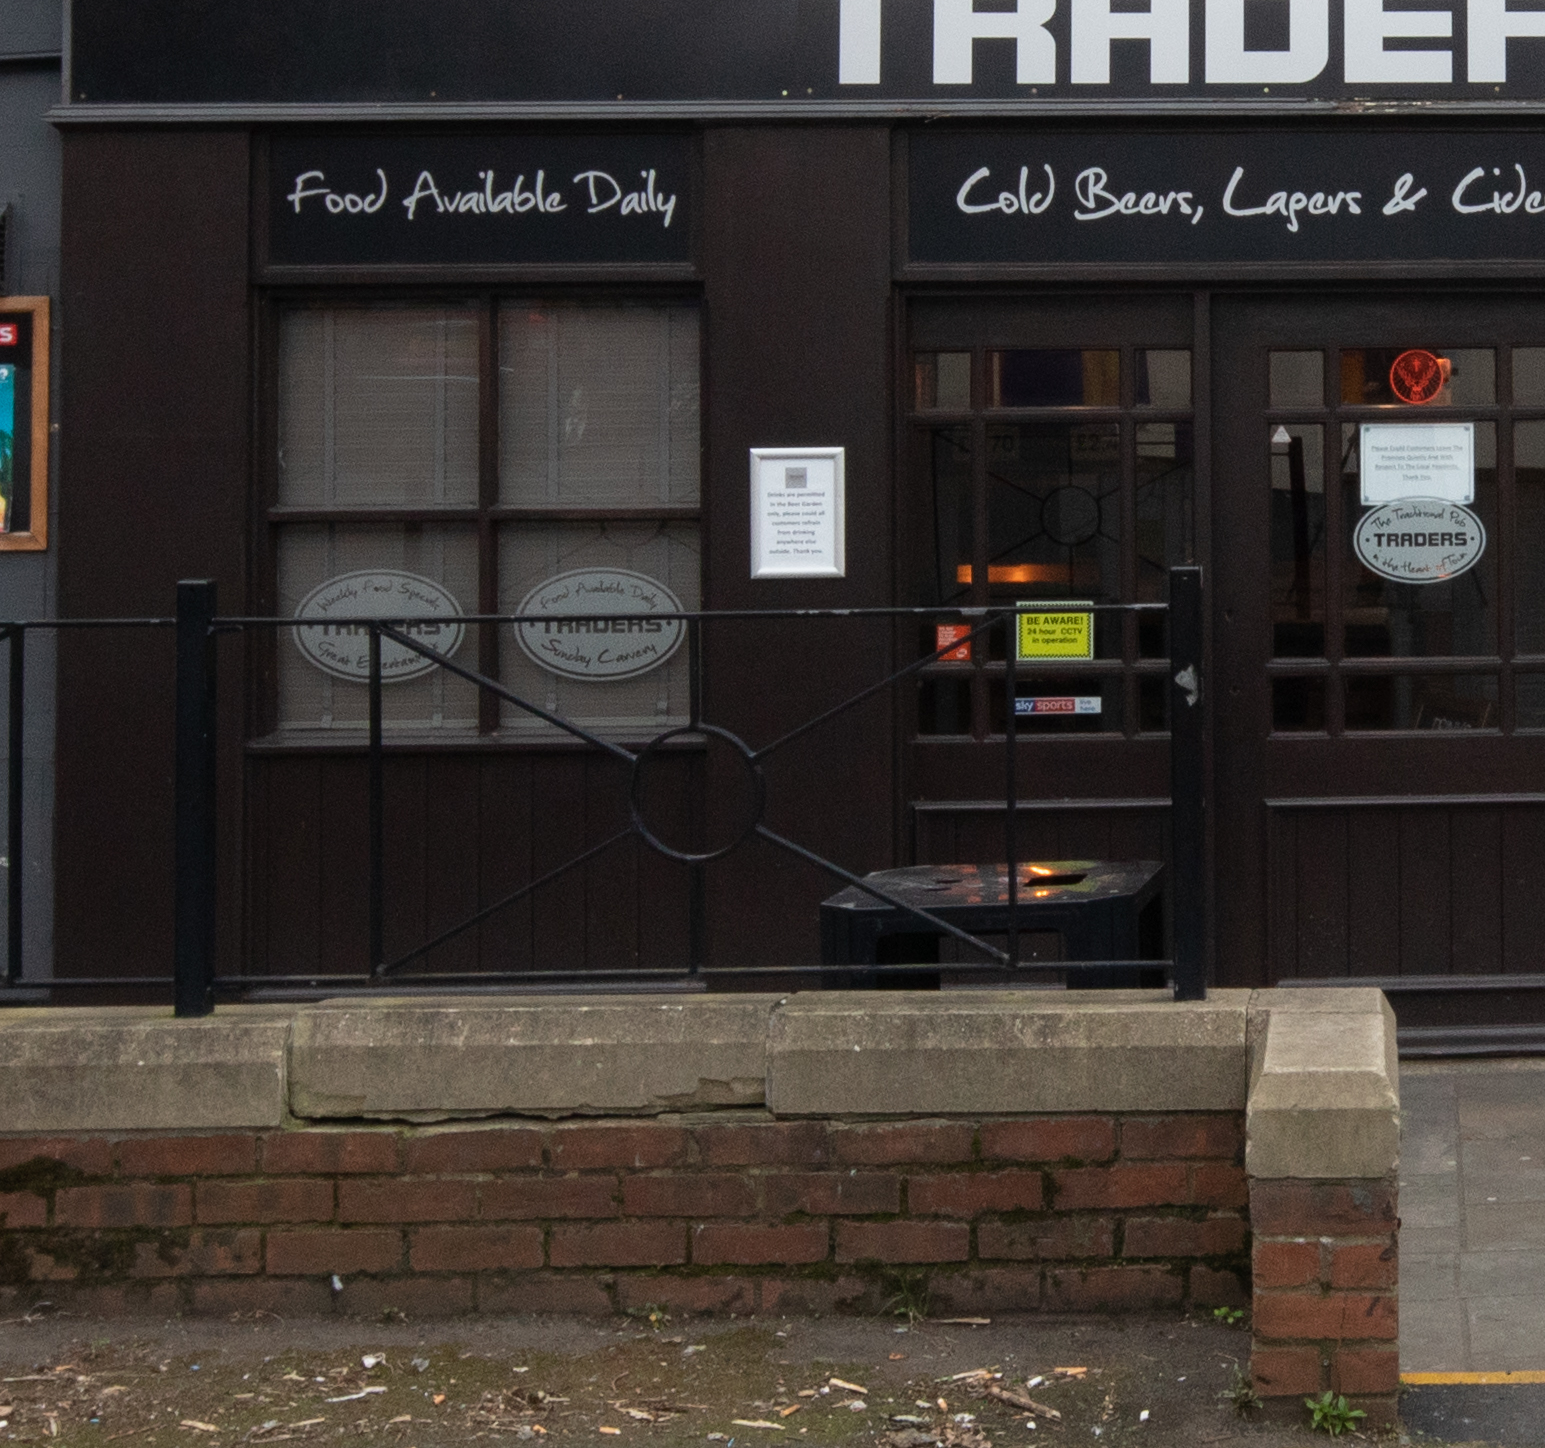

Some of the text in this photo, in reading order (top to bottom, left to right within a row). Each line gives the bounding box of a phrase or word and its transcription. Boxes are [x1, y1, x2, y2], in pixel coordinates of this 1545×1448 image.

[288, 169, 677, 227] Food Available Daily
[956, 166, 1054, 214] Cold
[1075, 167, 1202, 225] Beers,
[1222, 166, 1362, 232] Lagers
[1382, 173, 1426, 214] &
[1370, 507, 1467, 531] The Traditional Pub
[1373, 532, 1467, 547] TRADERS
[362, 579, 393, 593] Food
[541, 586, 569, 610] Food
[575, 580, 625, 596] Available
[1027, 616, 1084, 625] BE AWARE!
[318, 641, 351, 666] Great
[541, 638, 658, 668] Sunday Carvery
[1015, 700, 1074, 711] sky sports
